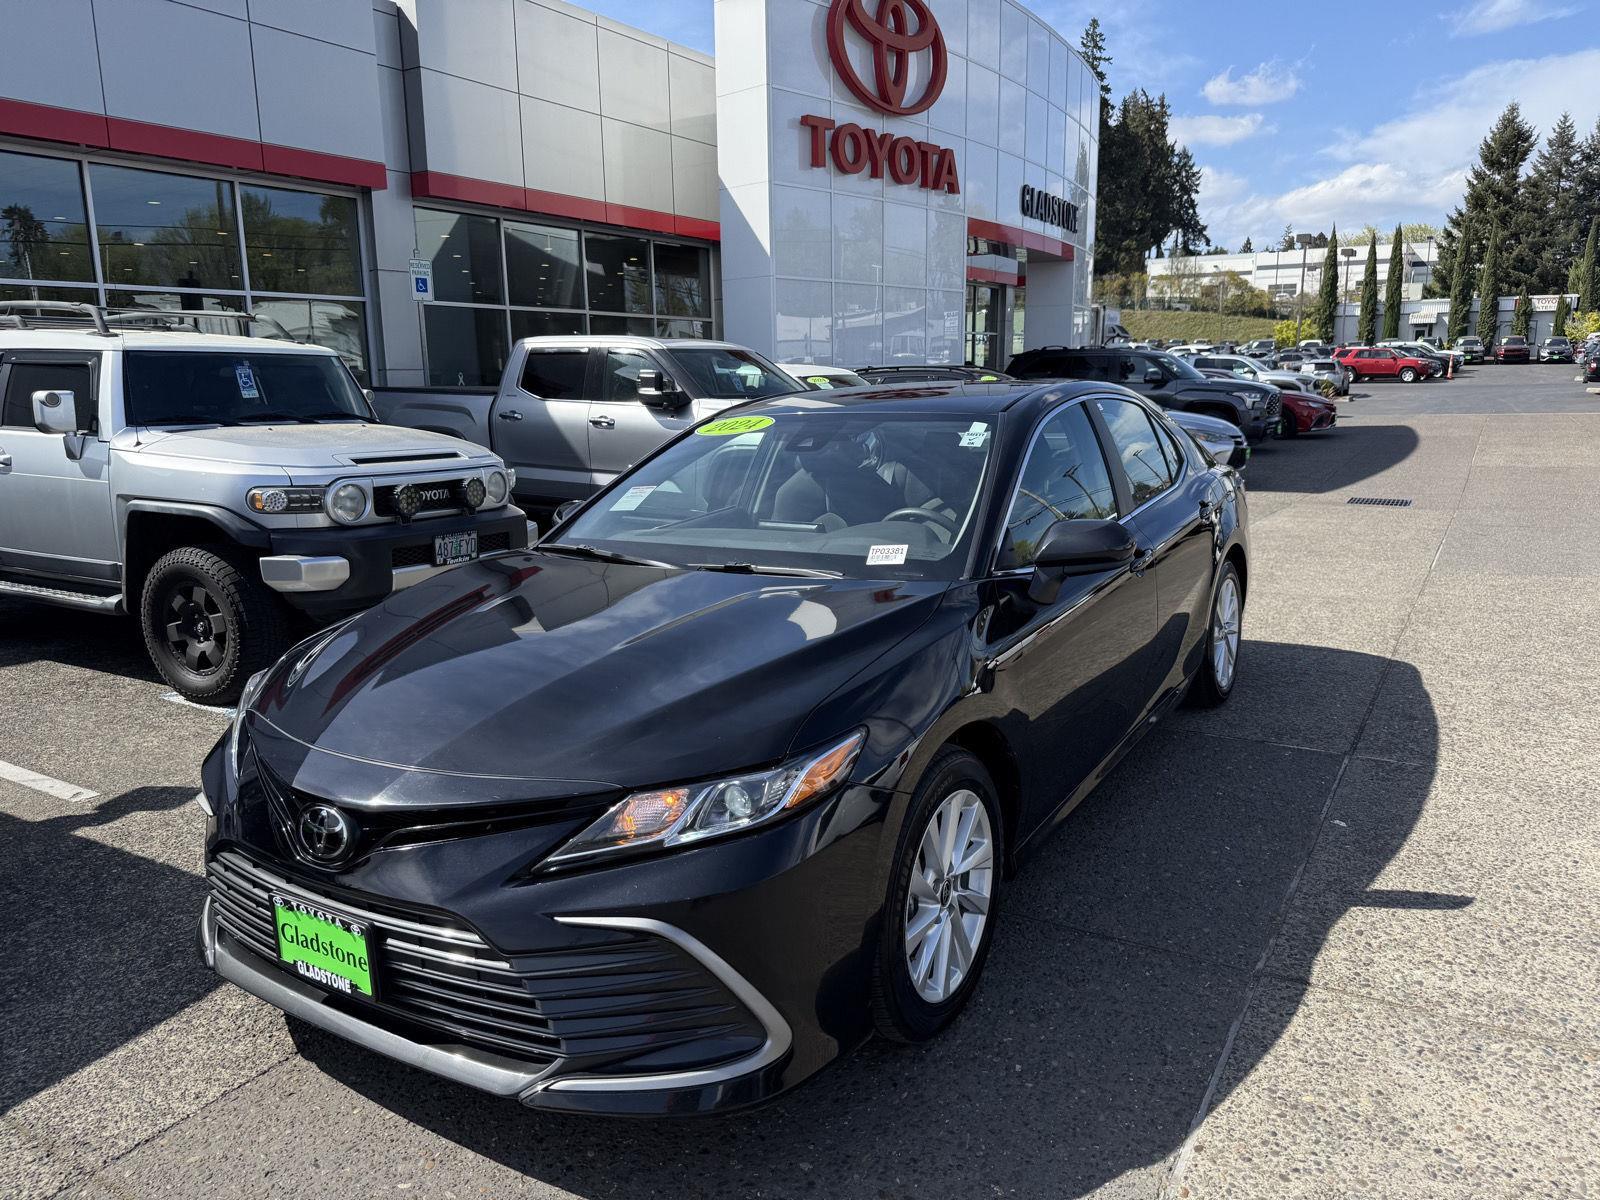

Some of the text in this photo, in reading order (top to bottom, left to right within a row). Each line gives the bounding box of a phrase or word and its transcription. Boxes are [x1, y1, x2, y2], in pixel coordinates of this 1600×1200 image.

[800, 114, 961, 195] TOYOTA
[1020, 184, 1079, 233] GLADSTONE
[410, 262, 431, 270] RESERVED
[703, 418, 766, 432] 2024
[420, 489, 450, 501] OYOTA
[871, 547, 904, 555] TP03381
[291, 901, 343, 929] TOYOTA
[281, 922, 368, 973] Gladstone
[297, 960, 352, 994] GLADSTONE
